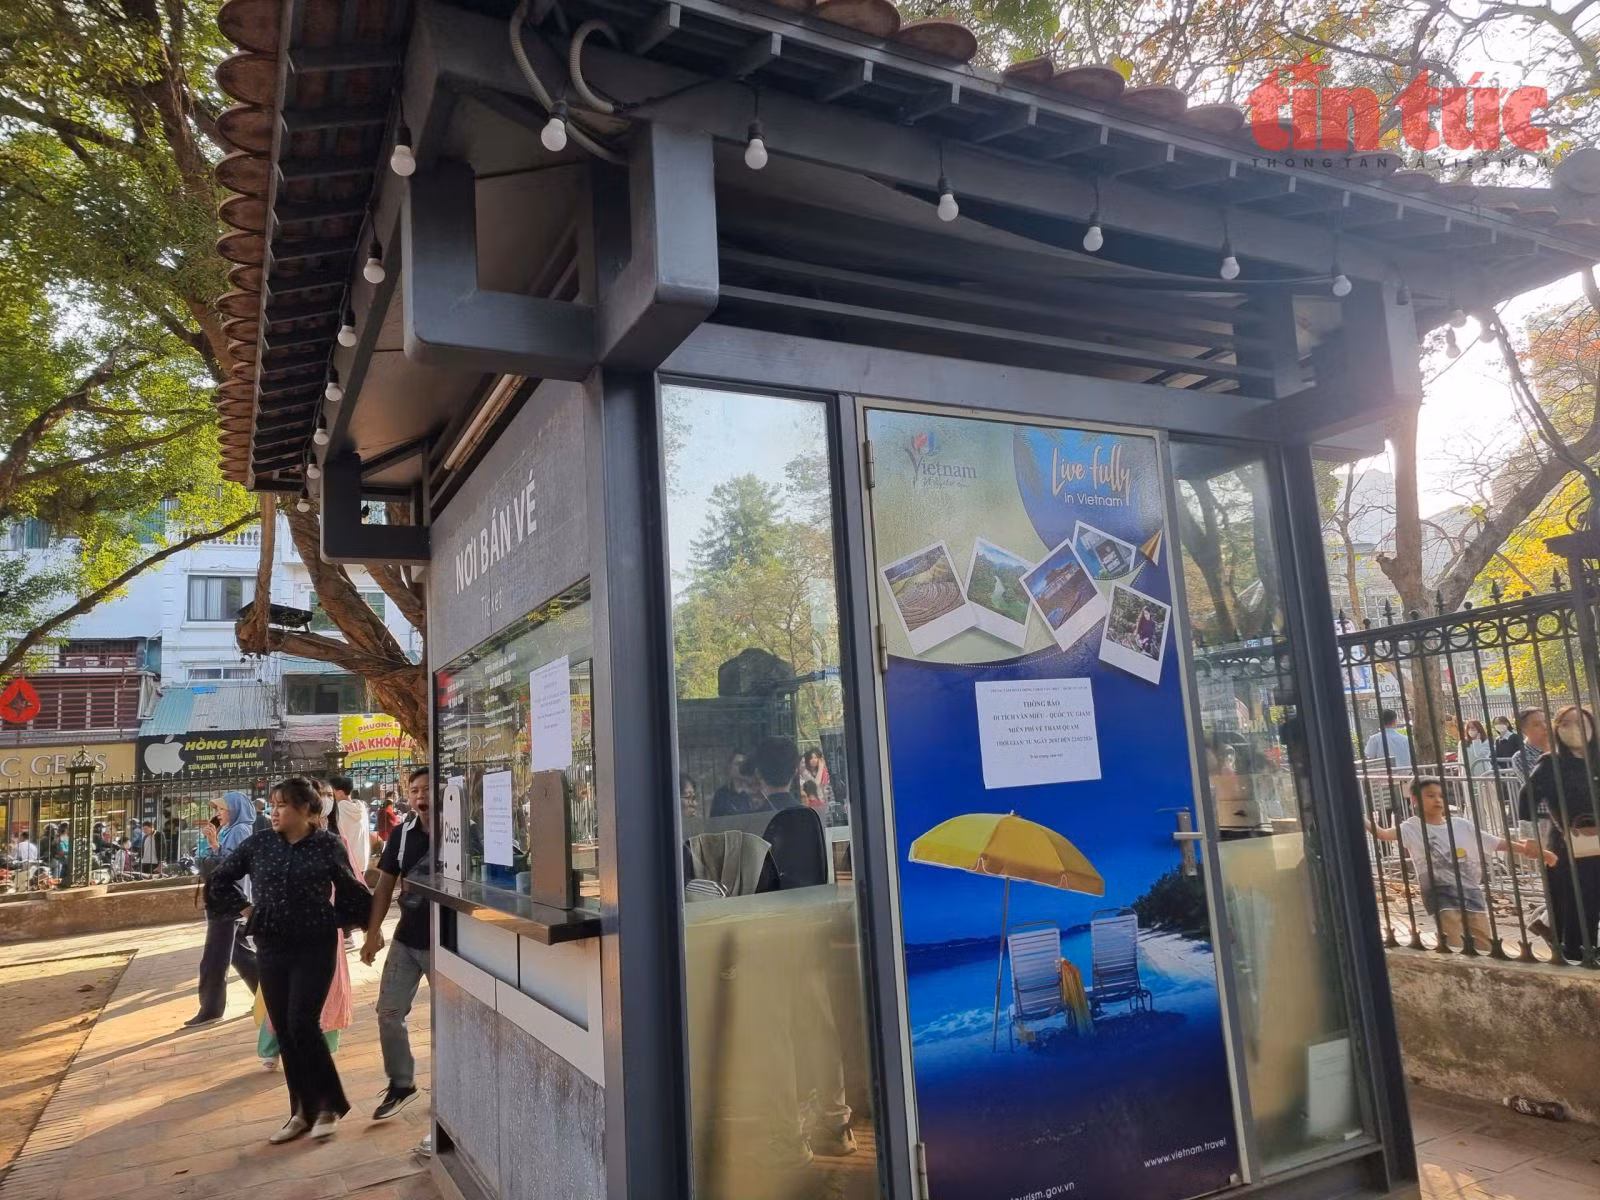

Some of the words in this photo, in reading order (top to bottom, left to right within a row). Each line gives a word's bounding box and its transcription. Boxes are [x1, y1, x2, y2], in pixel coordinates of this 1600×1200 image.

[904, 445, 978, 489] Vietnam
[1052, 447, 1087, 497] Live
[1089, 444, 1131, 507] fully
[1063, 490, 1075, 504] in
[1076, 492, 1124, 507] Vietnam
[455, 536, 478, 595] NƠI
[480, 506, 511, 574] BÁN
[513, 468, 537, 543] VÉ
[480, 587, 502, 621] Ticket
[230, 736, 267, 749] PHÁT
[30, 752, 107, 776] GES
[445, 821, 460, 844] Close
